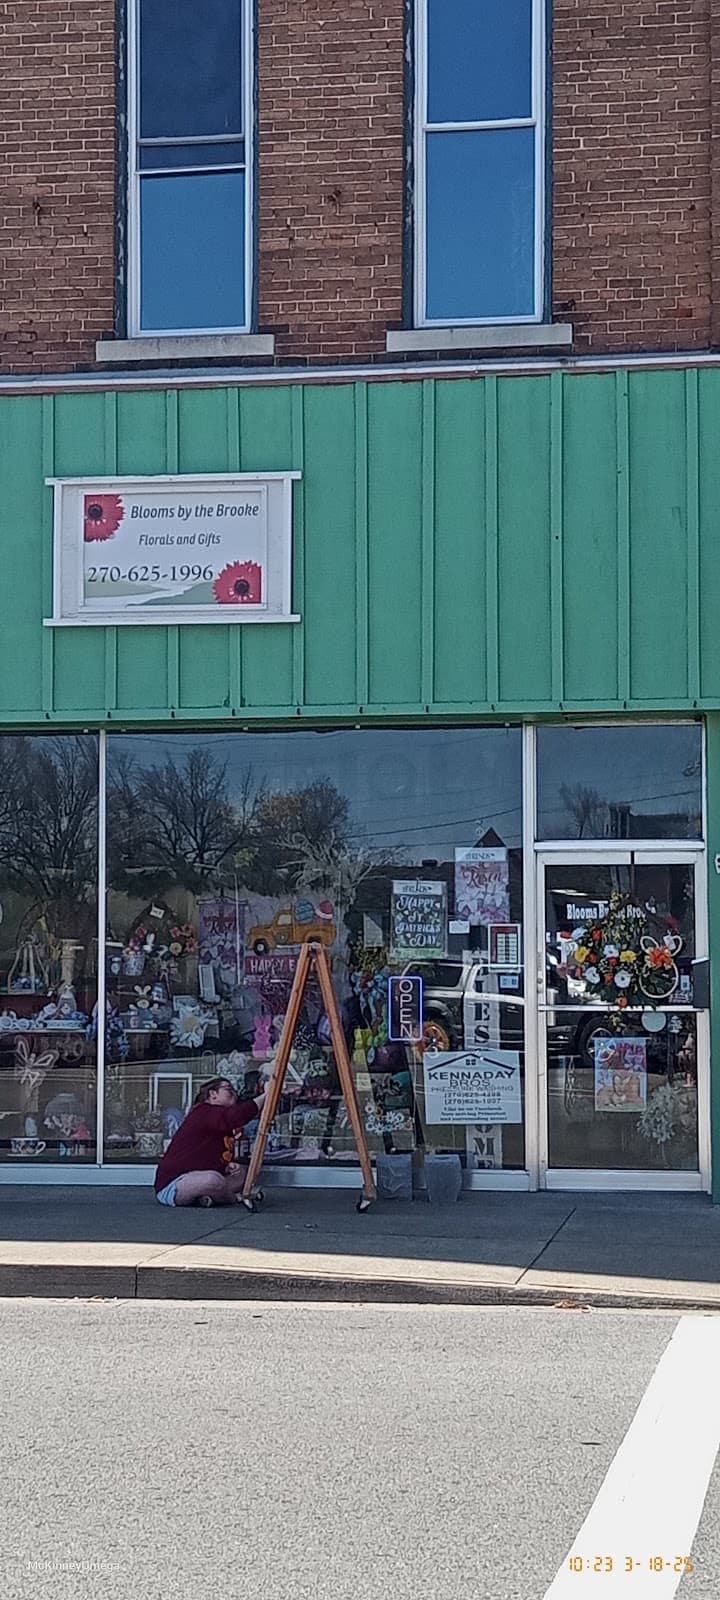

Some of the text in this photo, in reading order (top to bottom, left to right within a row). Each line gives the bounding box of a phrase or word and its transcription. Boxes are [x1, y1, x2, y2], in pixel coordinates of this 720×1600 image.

[130, 502, 259, 521] Blooms by the Brooke
[138, 532, 221, 547] Florals and Gifts
[87, 564, 214, 583] 270-625-1996
[566, 903, 598, 920] Blooms
[250, 958, 284, 974] HAPPY
[399, 979, 413, 1038] OPEN
[428, 1070, 515, 1080] KENNADAY
[449, 1079, 491, 1088] BROS
